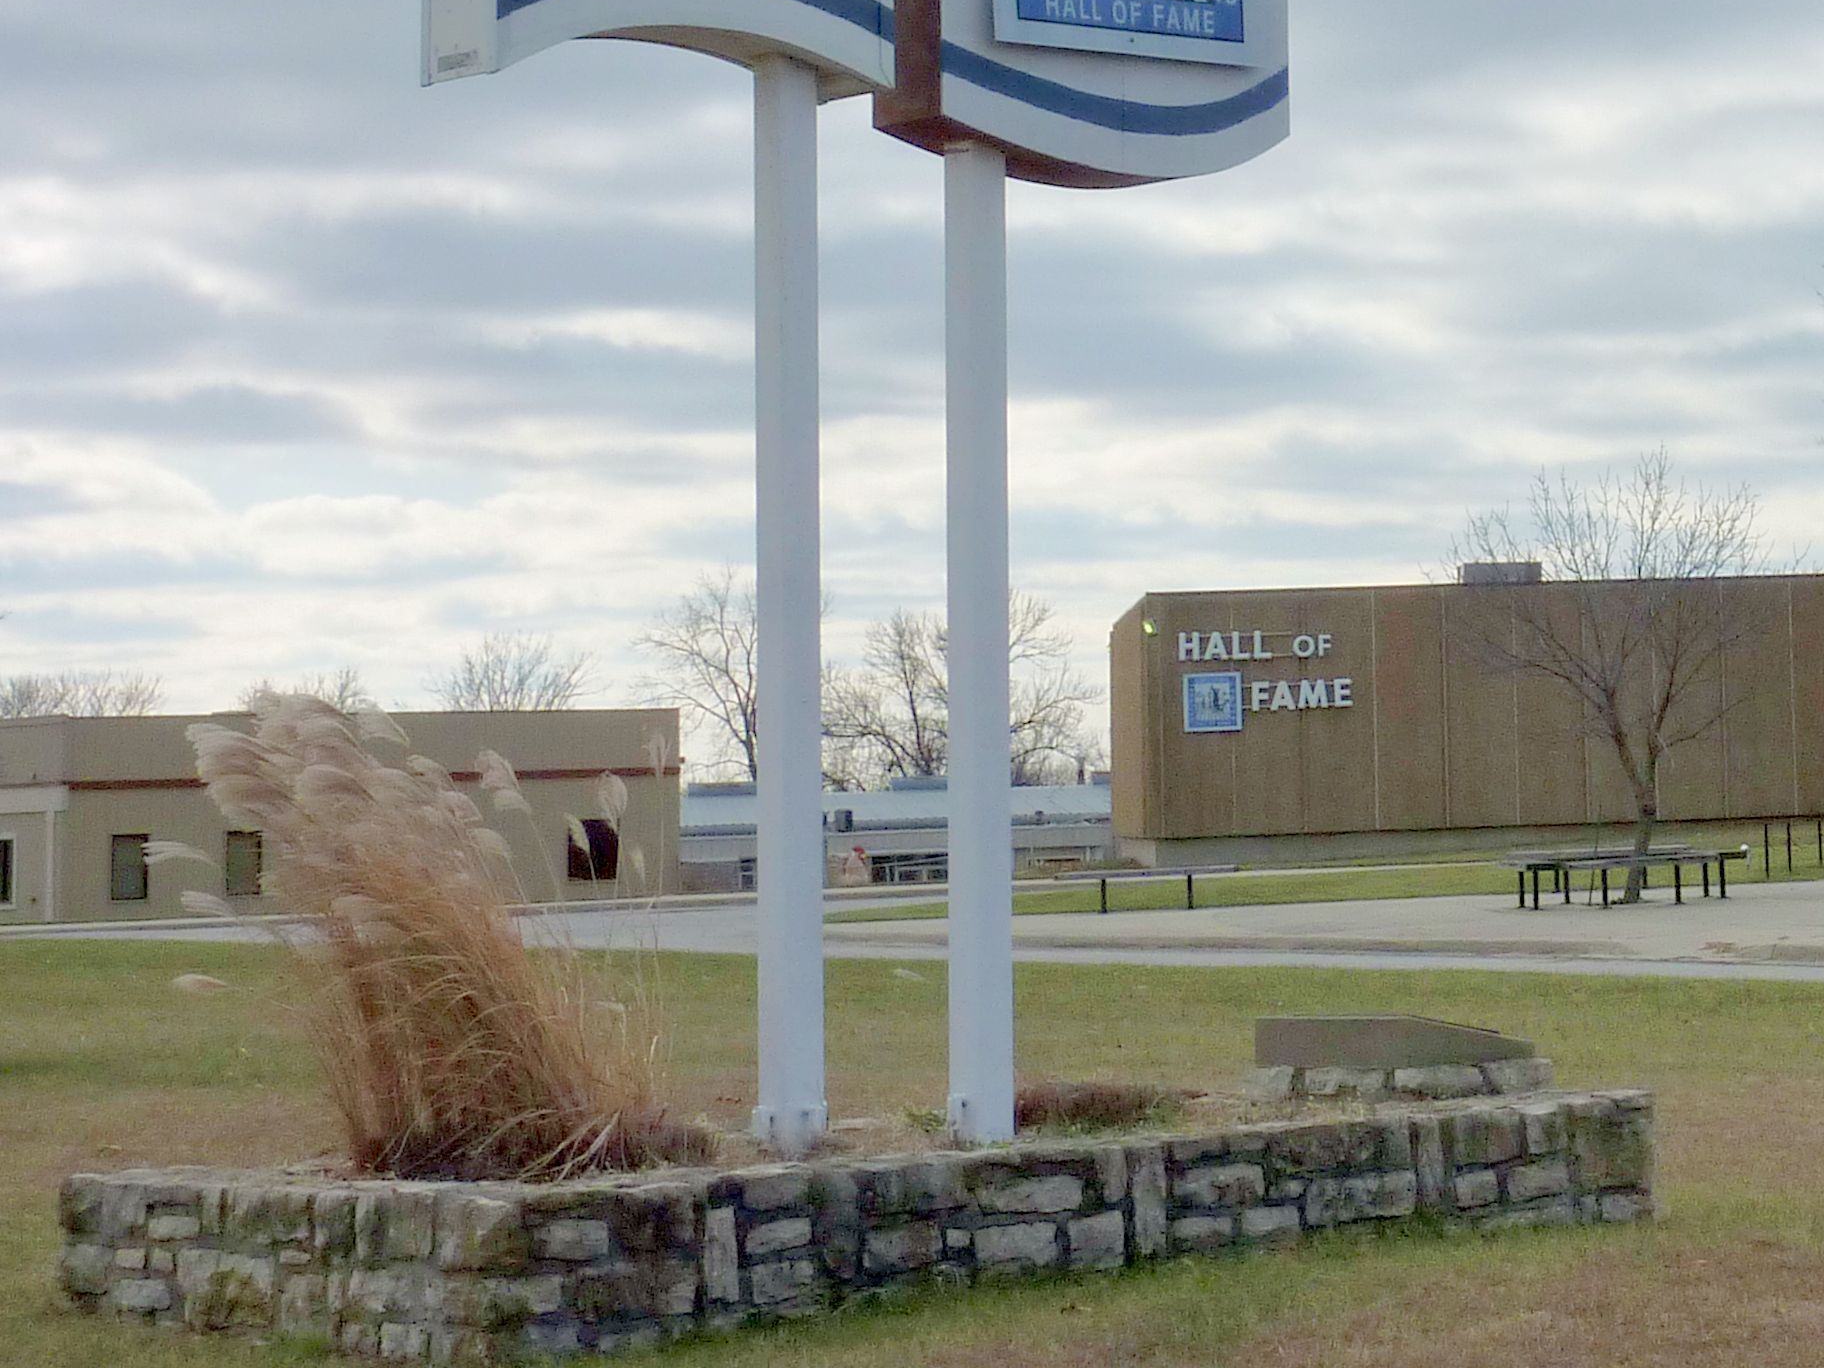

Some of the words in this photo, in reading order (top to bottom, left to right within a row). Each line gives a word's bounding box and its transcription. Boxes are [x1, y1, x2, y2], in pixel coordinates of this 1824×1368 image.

[1112, 0, 1142, 25] OF
[1153, 4, 1215, 33] FAME
[1178, 630, 1272, 661] HALL
[1292, 634, 1332, 658] OF
[1251, 678, 1353, 712] FAME
